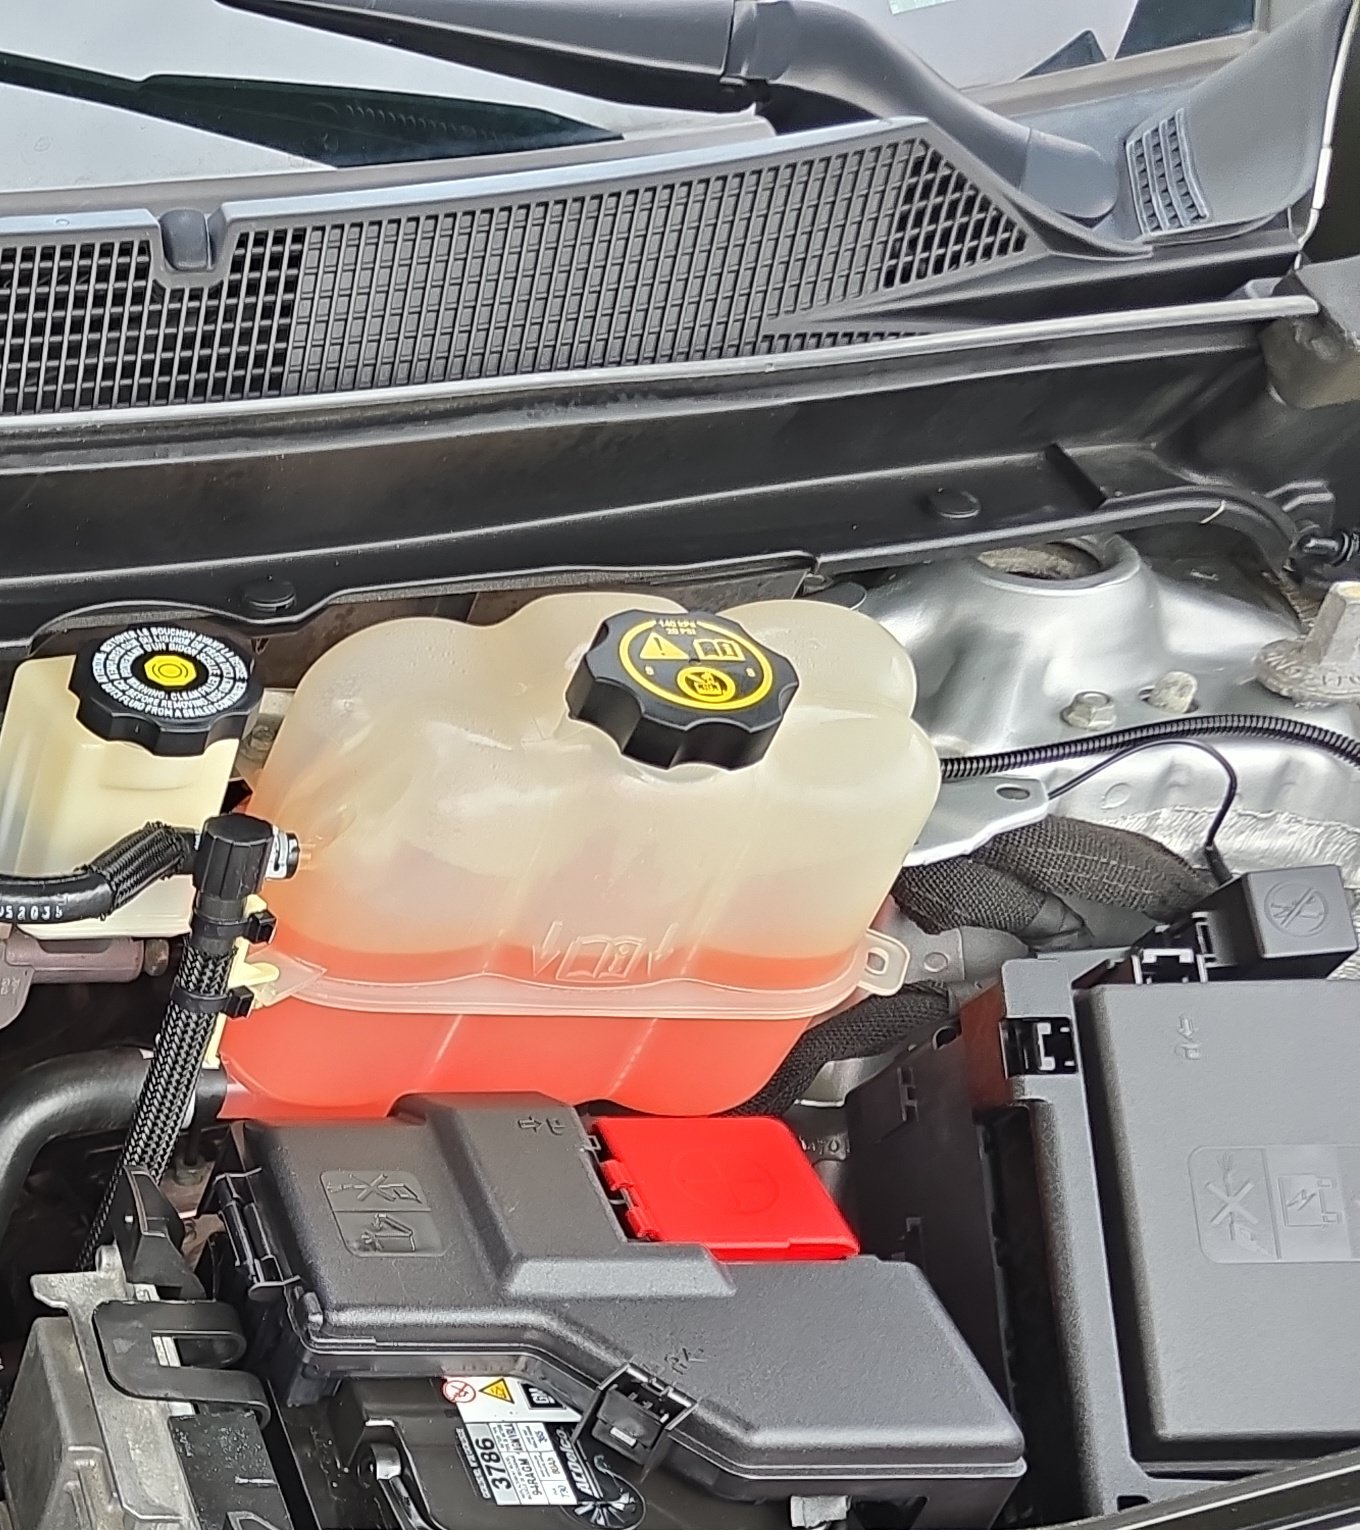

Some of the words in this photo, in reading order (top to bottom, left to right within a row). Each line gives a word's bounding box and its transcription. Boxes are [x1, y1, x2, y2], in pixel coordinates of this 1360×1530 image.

[125, 689, 159, 706] BEFORE
[145, 705, 173, 717] FROM
[175, 709, 182, 718] A
[473, 1437, 513, 1489] 3786
[552, 1428, 592, 1495] ACDelco
